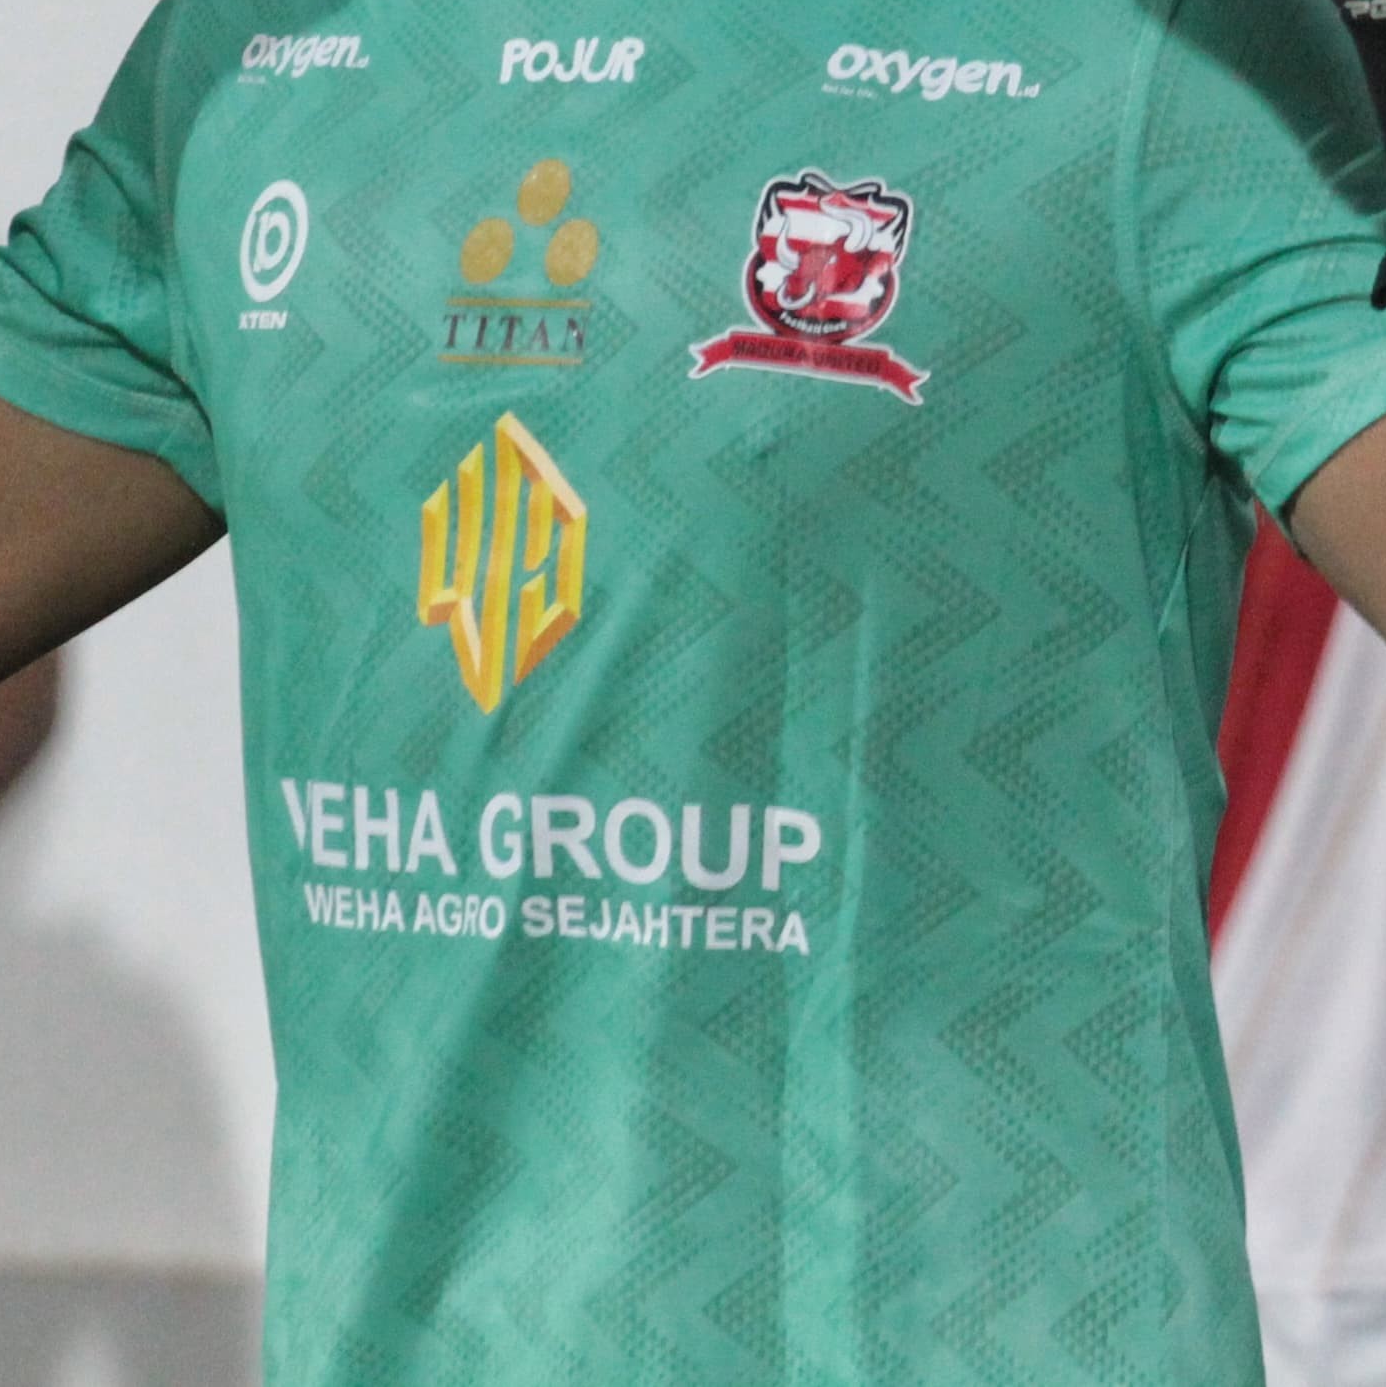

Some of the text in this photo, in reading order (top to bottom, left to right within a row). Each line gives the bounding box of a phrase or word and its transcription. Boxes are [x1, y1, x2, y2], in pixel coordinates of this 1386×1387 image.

[500, 38, 645, 84] POJUR
[444, 313, 589, 353] TITAN
[479, 791, 822, 892] GROUP
[303, 882, 811, 955] WEHA AGRO SEJAHTERA
